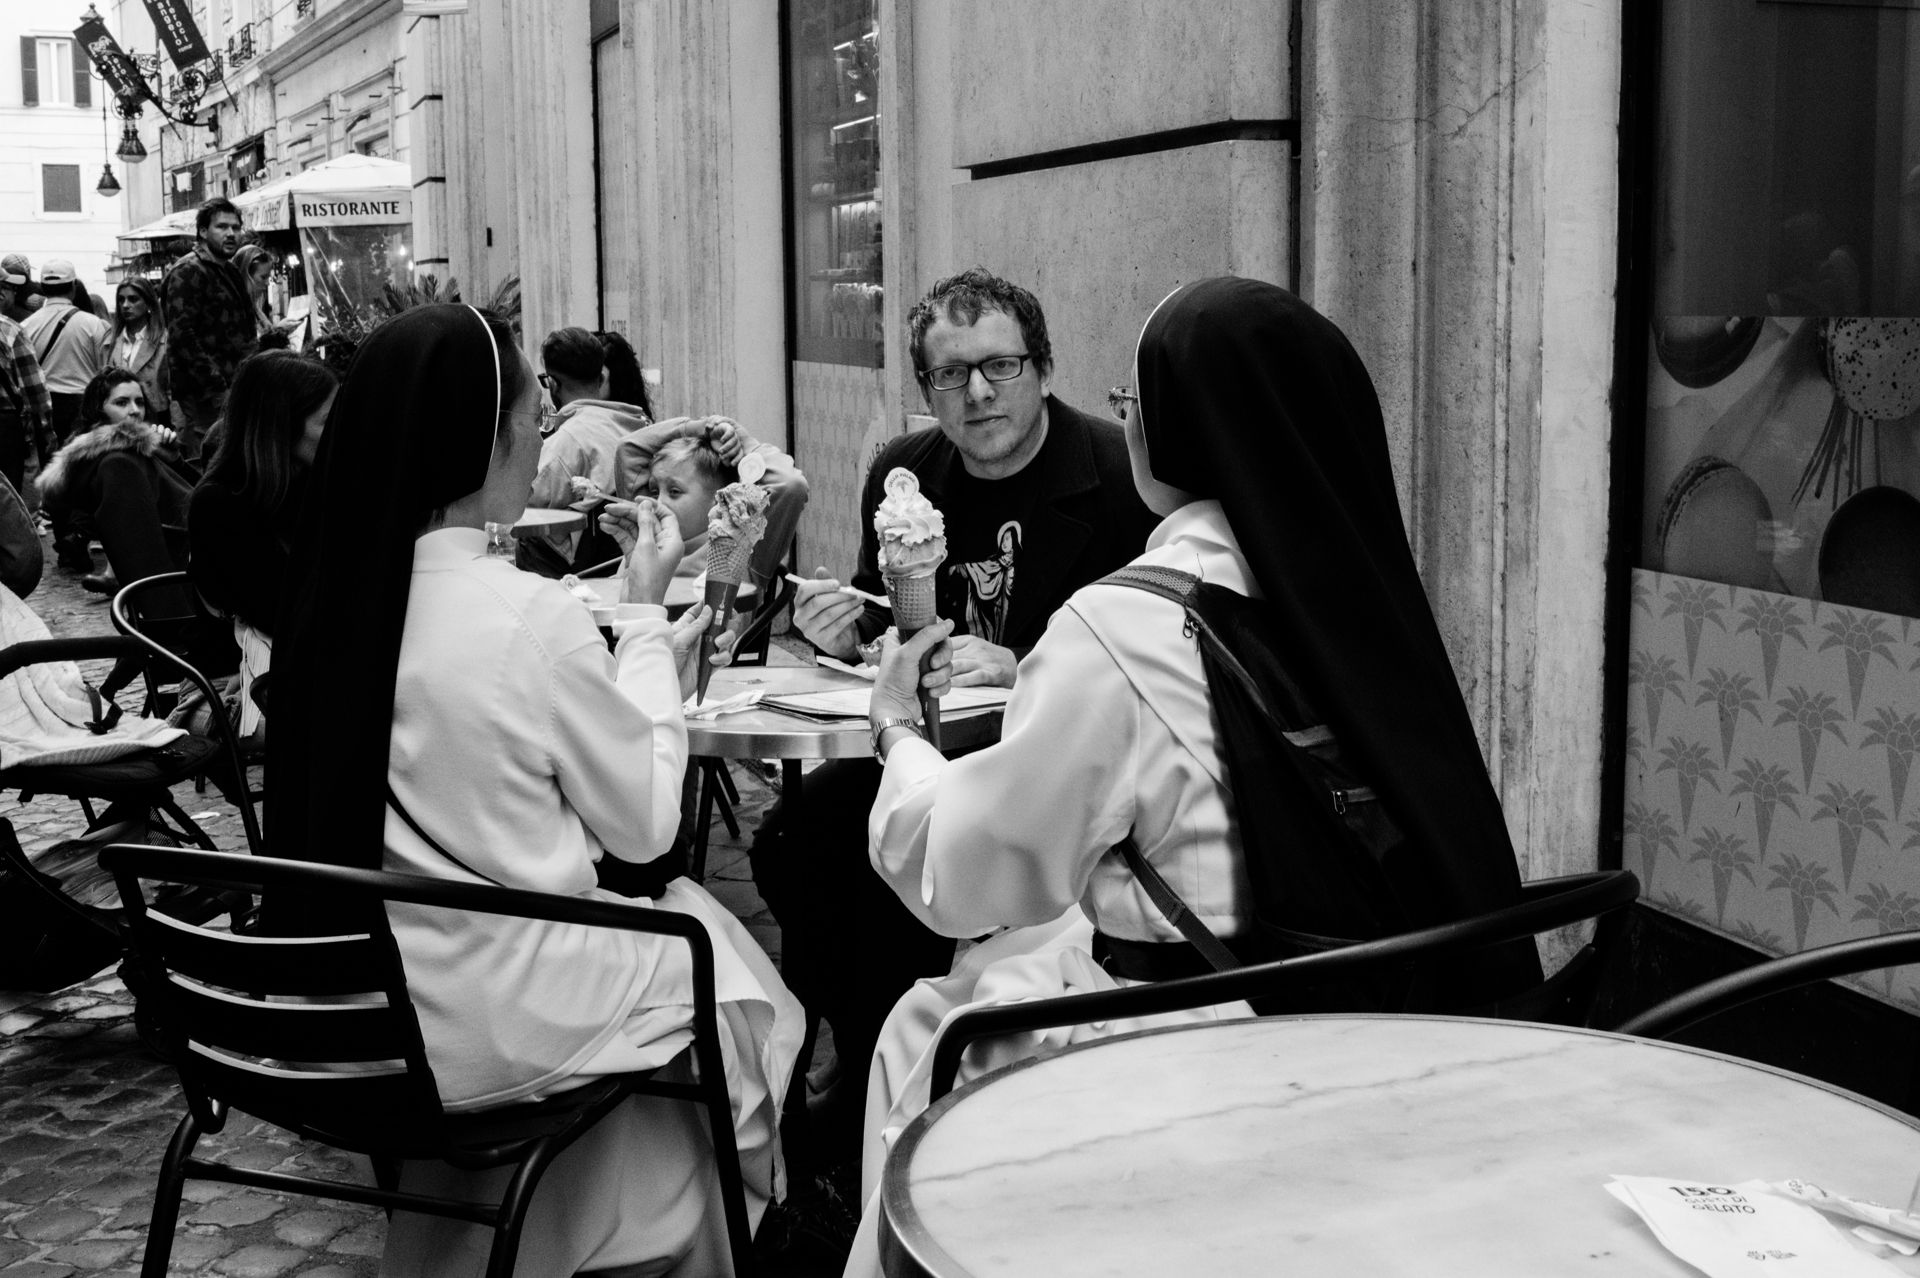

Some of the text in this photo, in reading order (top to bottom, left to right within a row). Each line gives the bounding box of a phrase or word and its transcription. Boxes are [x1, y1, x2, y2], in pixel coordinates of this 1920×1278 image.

[157, 2, 182, 46] angelo
[302, 201, 400, 217] RISTORANTE
[1668, 1186, 1737, 1197] 150
[1731, 1195, 1748, 1203] DI
[1692, 1203, 1756, 1214] GELATO
